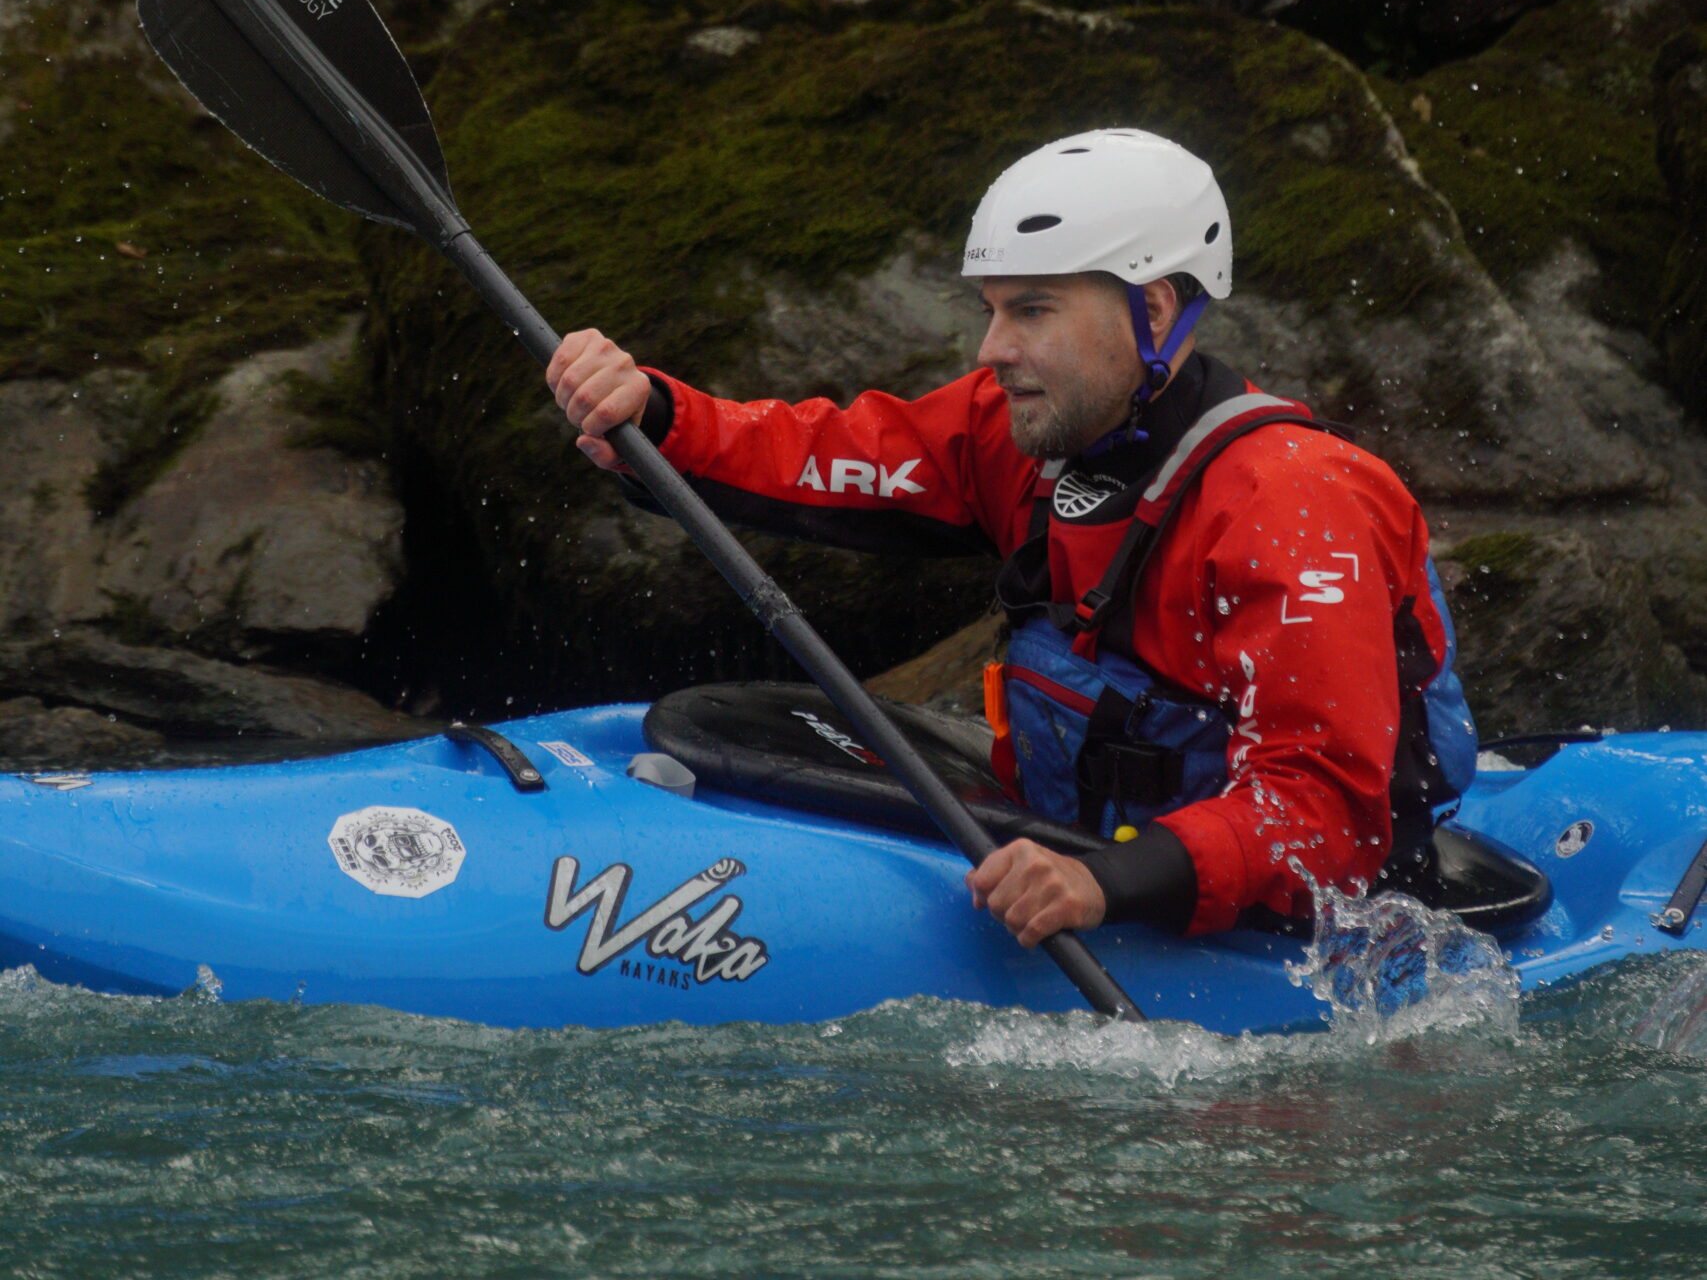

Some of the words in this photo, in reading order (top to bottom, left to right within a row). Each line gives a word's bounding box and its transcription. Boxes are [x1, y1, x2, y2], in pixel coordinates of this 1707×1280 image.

[796, 454, 927, 497] ARK
[544, 855, 770, 985] Waka
[619, 958, 691, 991] KAYAKS
